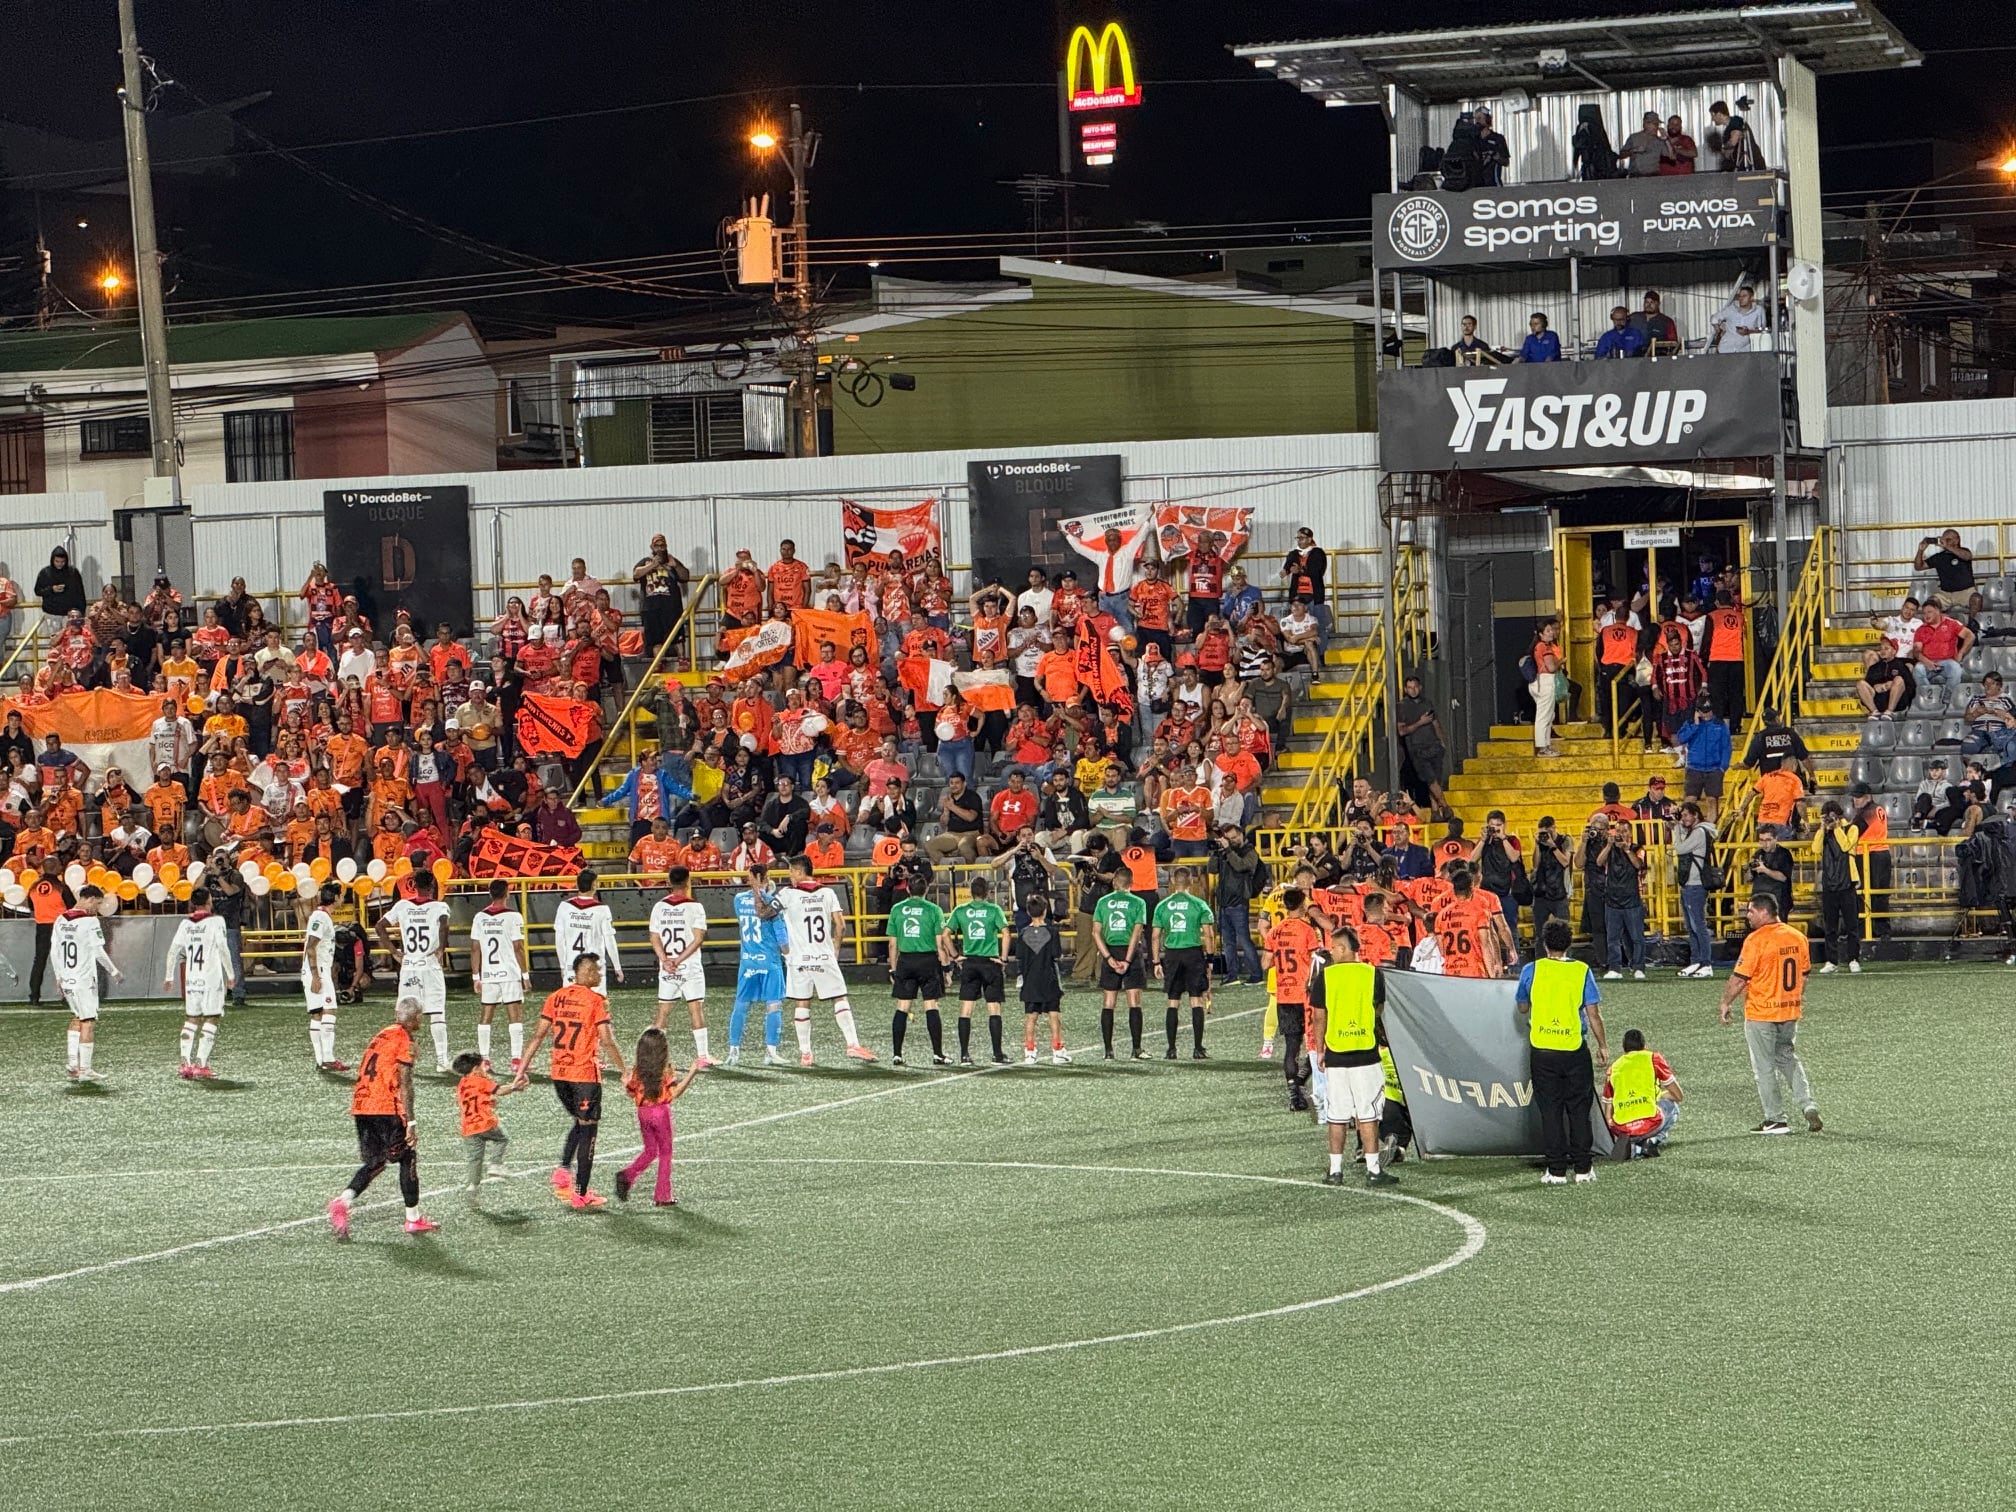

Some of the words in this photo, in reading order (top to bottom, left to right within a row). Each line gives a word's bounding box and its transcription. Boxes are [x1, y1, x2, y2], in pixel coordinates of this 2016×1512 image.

[1073, 94, 1125, 108] McDonald's
[1396, 200, 1443, 222] SPORTING
[1472, 196, 1598, 220] Somos
[1659, 198, 1738, 216] SOMOS
[1642, 215, 1703, 233] PURA
[1706, 211, 1755, 230] VIDA
[1463, 218, 1620, 252] Sporting
[1397, 239, 1426, 256] FOOTBALL
[1015, 476, 1074, 494] BLOQUE
[1630, 537, 1673, 546] Emergencia
[1634, 528, 1655, 536] Salida
[381, 535, 416, 591] D
[868, 546, 941, 574] PUNARENAS
[1765, 734, 1791, 743] FUERZA
[1830, 739, 1852, 747] FILA
[606, 846, 626, 854] FILA
[646, 855, 667, 867] tigo
[406, 925, 431, 953] 35
[803, 914, 826, 944] 13
[487, 936, 500, 965] 2
[572, 931, 586, 955] 4
[661, 927, 687, 956] 25
[1443, 929, 1472, 956] 26
[60, 940, 78, 969] 19
[188, 943, 205, 972] 14
[1275, 948, 1298, 974] 15
[1782, 957, 1797, 992] 0
[554, 1021, 583, 1051] 27
[363, 1051, 379, 1082] 4
[462, 1096, 480, 1117] 27
